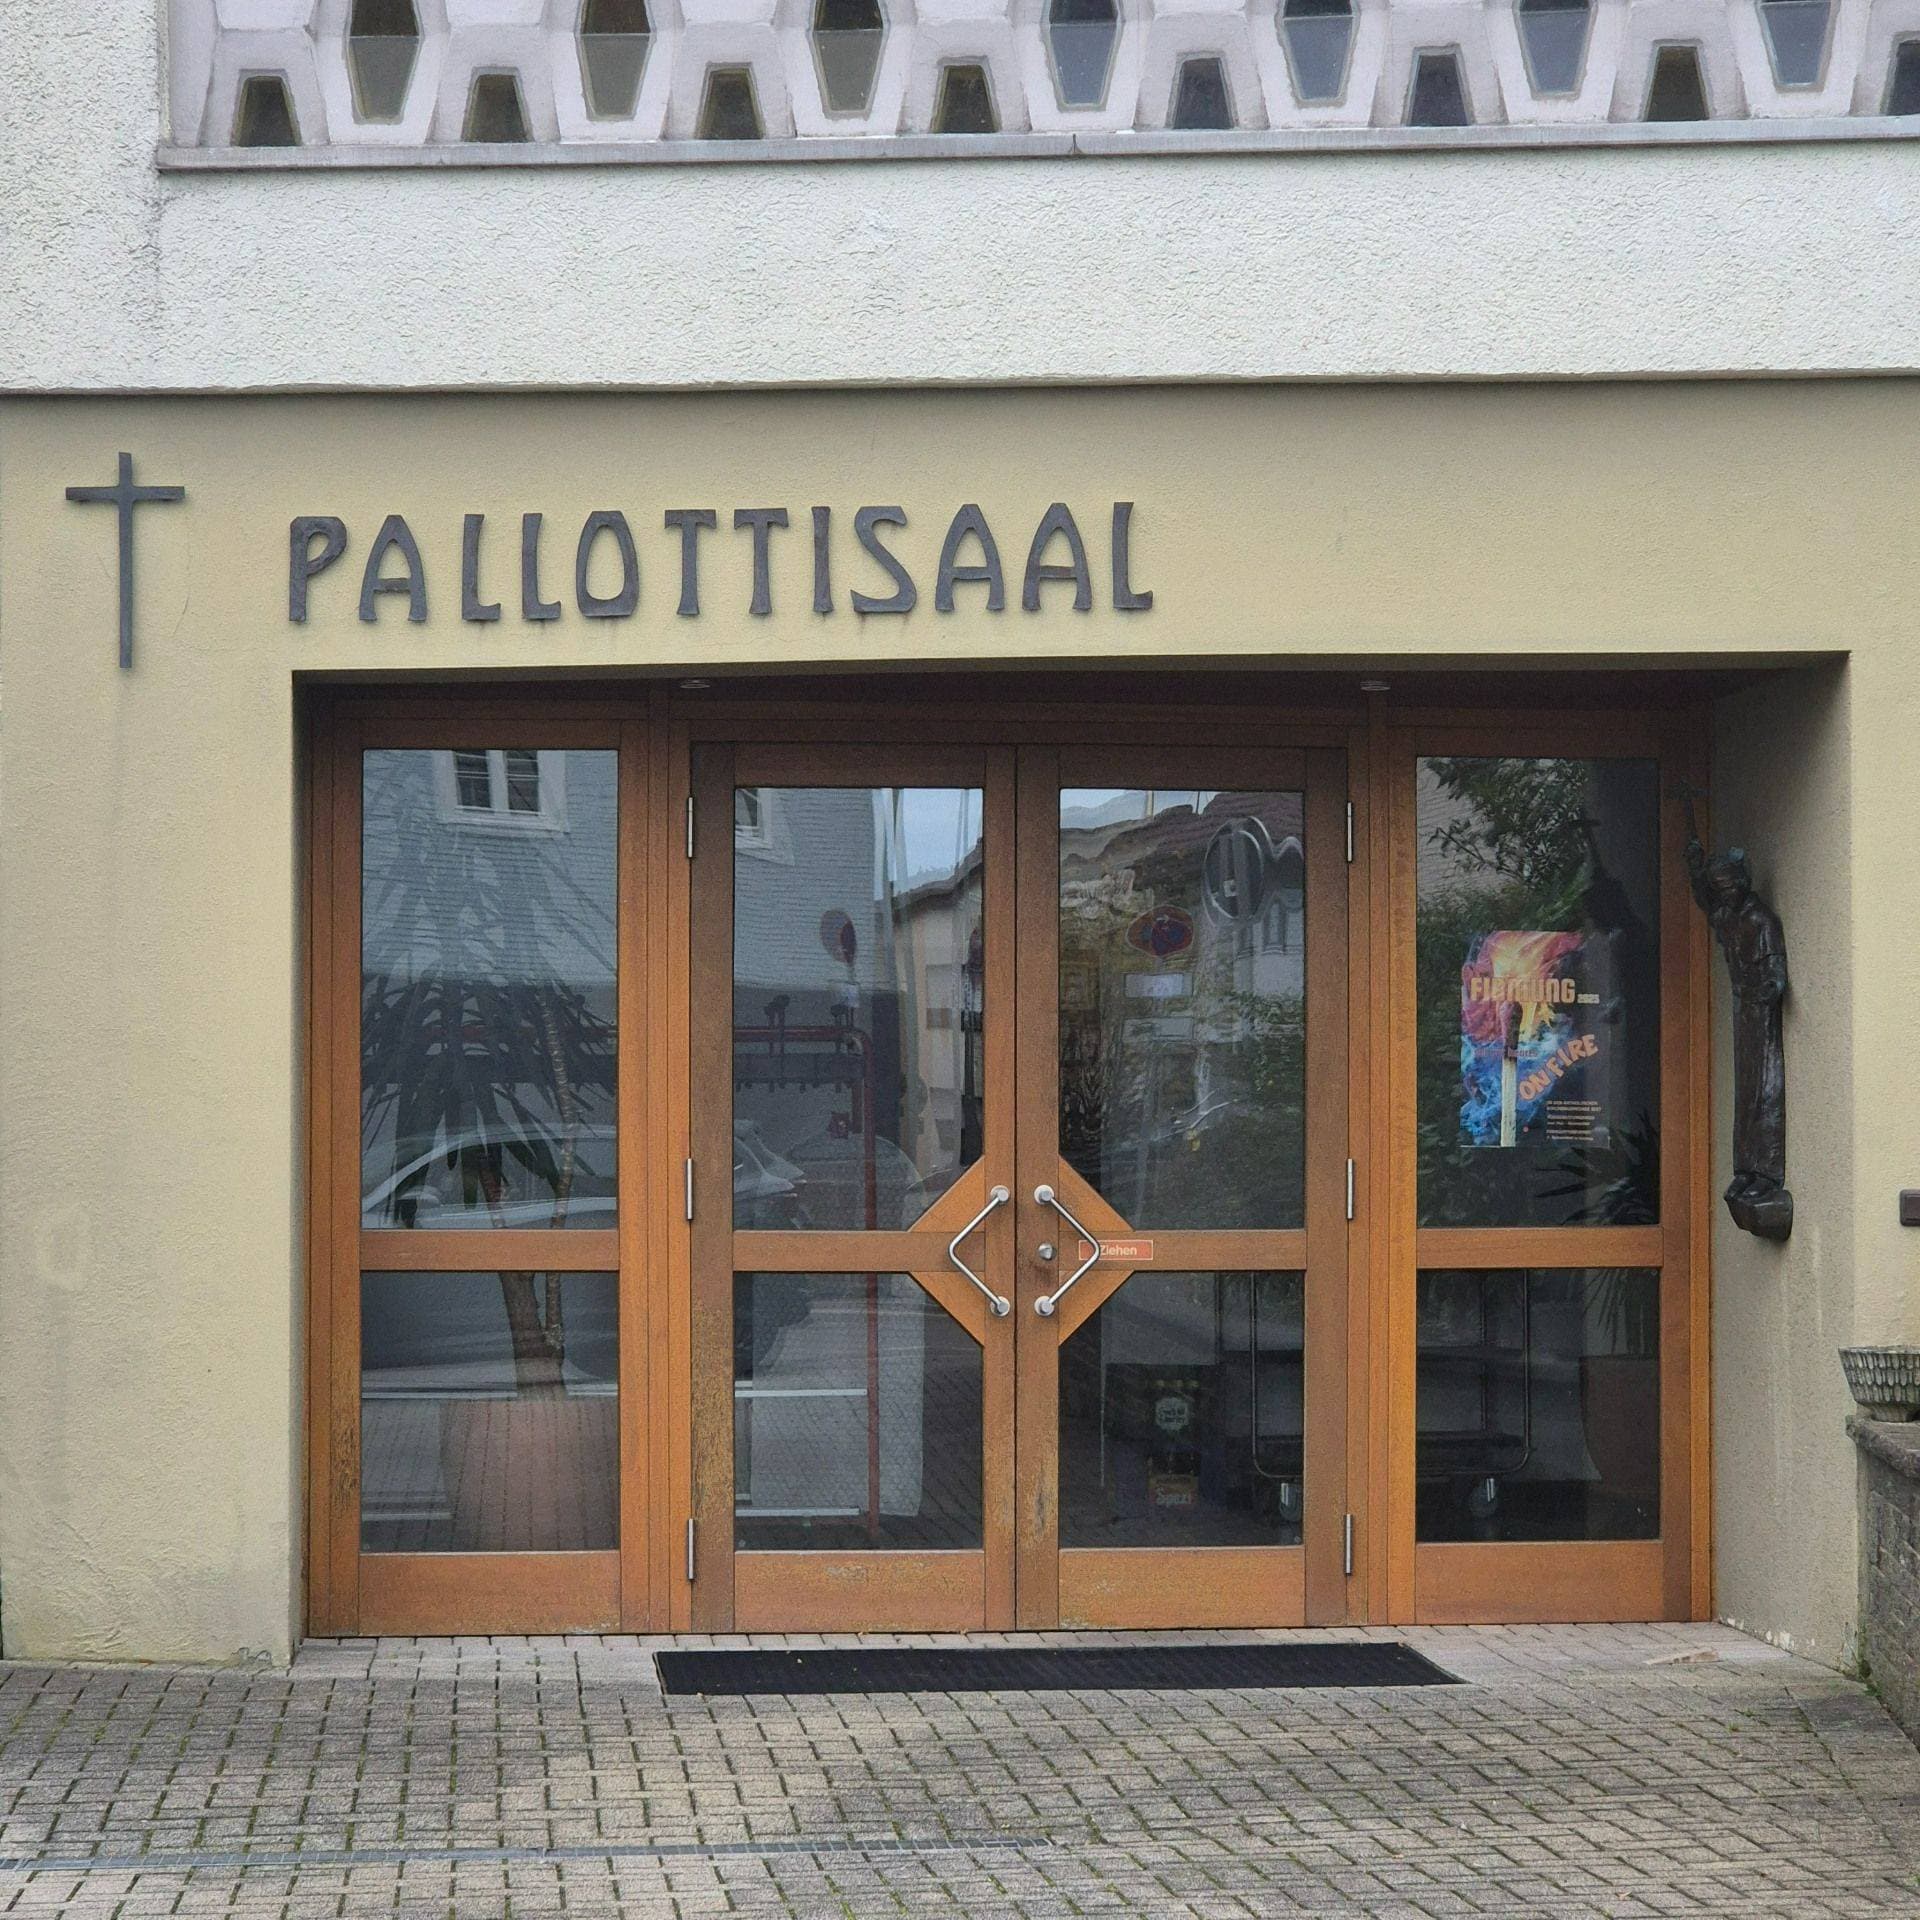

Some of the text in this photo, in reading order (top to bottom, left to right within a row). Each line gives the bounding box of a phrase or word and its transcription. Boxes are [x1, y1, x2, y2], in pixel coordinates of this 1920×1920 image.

[289, 502, 1154, 622] PALLOTTISAAL
[1519, 1033, 1599, 1101] ON FIRE
[1100, 1244, 1137, 1256] Ziehen
